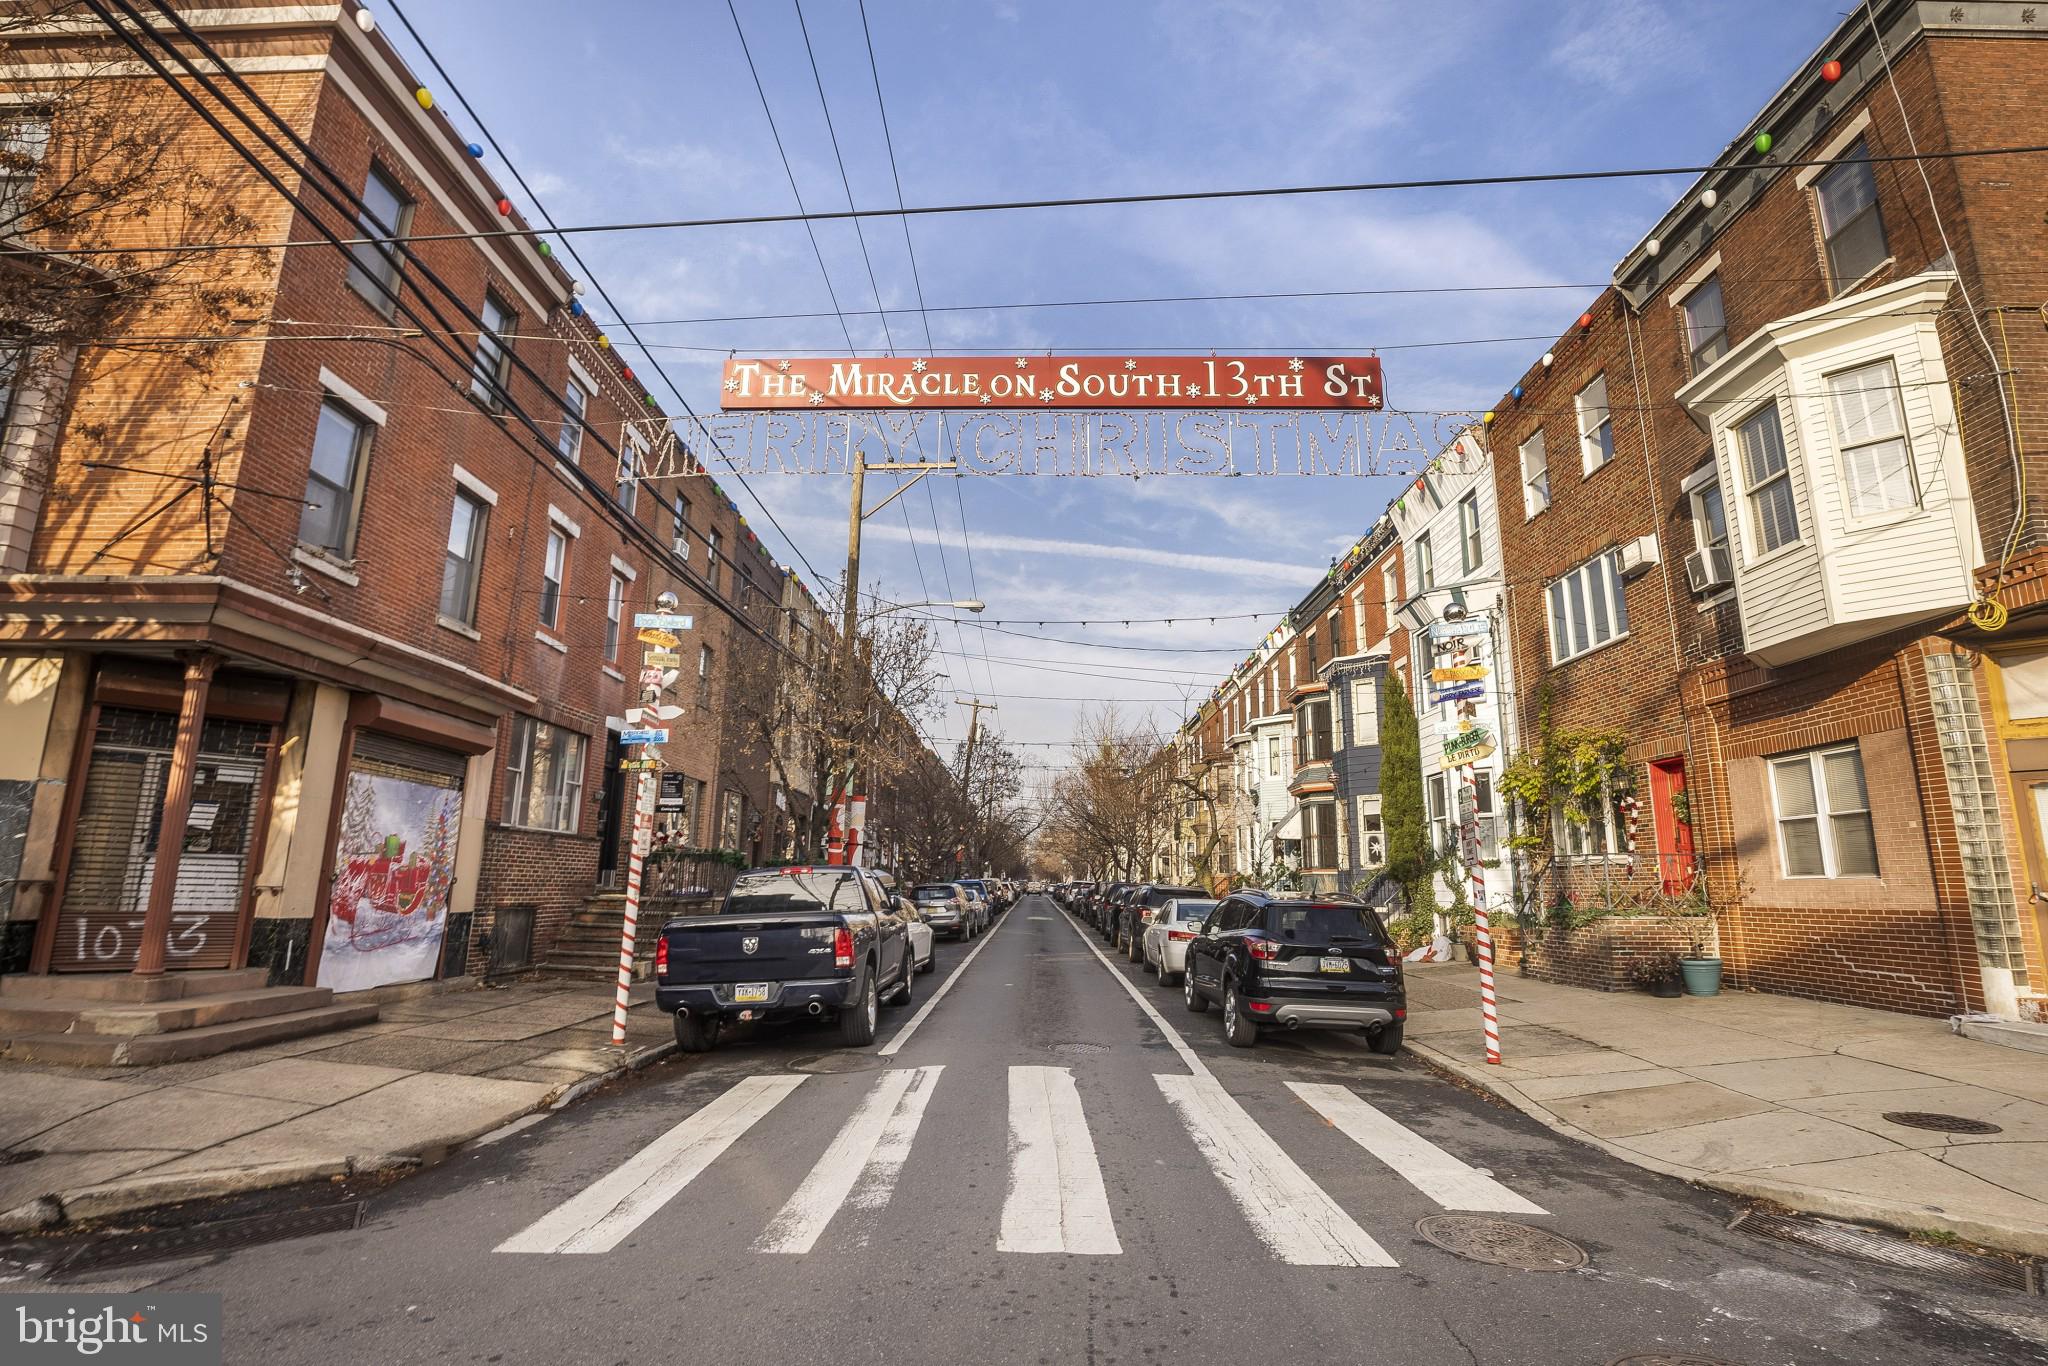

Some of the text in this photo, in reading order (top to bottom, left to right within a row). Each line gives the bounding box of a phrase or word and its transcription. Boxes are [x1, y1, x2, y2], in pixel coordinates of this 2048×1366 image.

[828, 362, 980, 405] MIRACLE
[991, 377, 1036, 398] ON
[1056, 362, 1182, 398] SOUTH
[1203, 360, 1304, 398] 13TH
[1324, 363, 1373, 398] ST
[615, 411, 1485, 482] MERRY CHRISTMAS
[1437, 637, 1465, 652] NOIR
